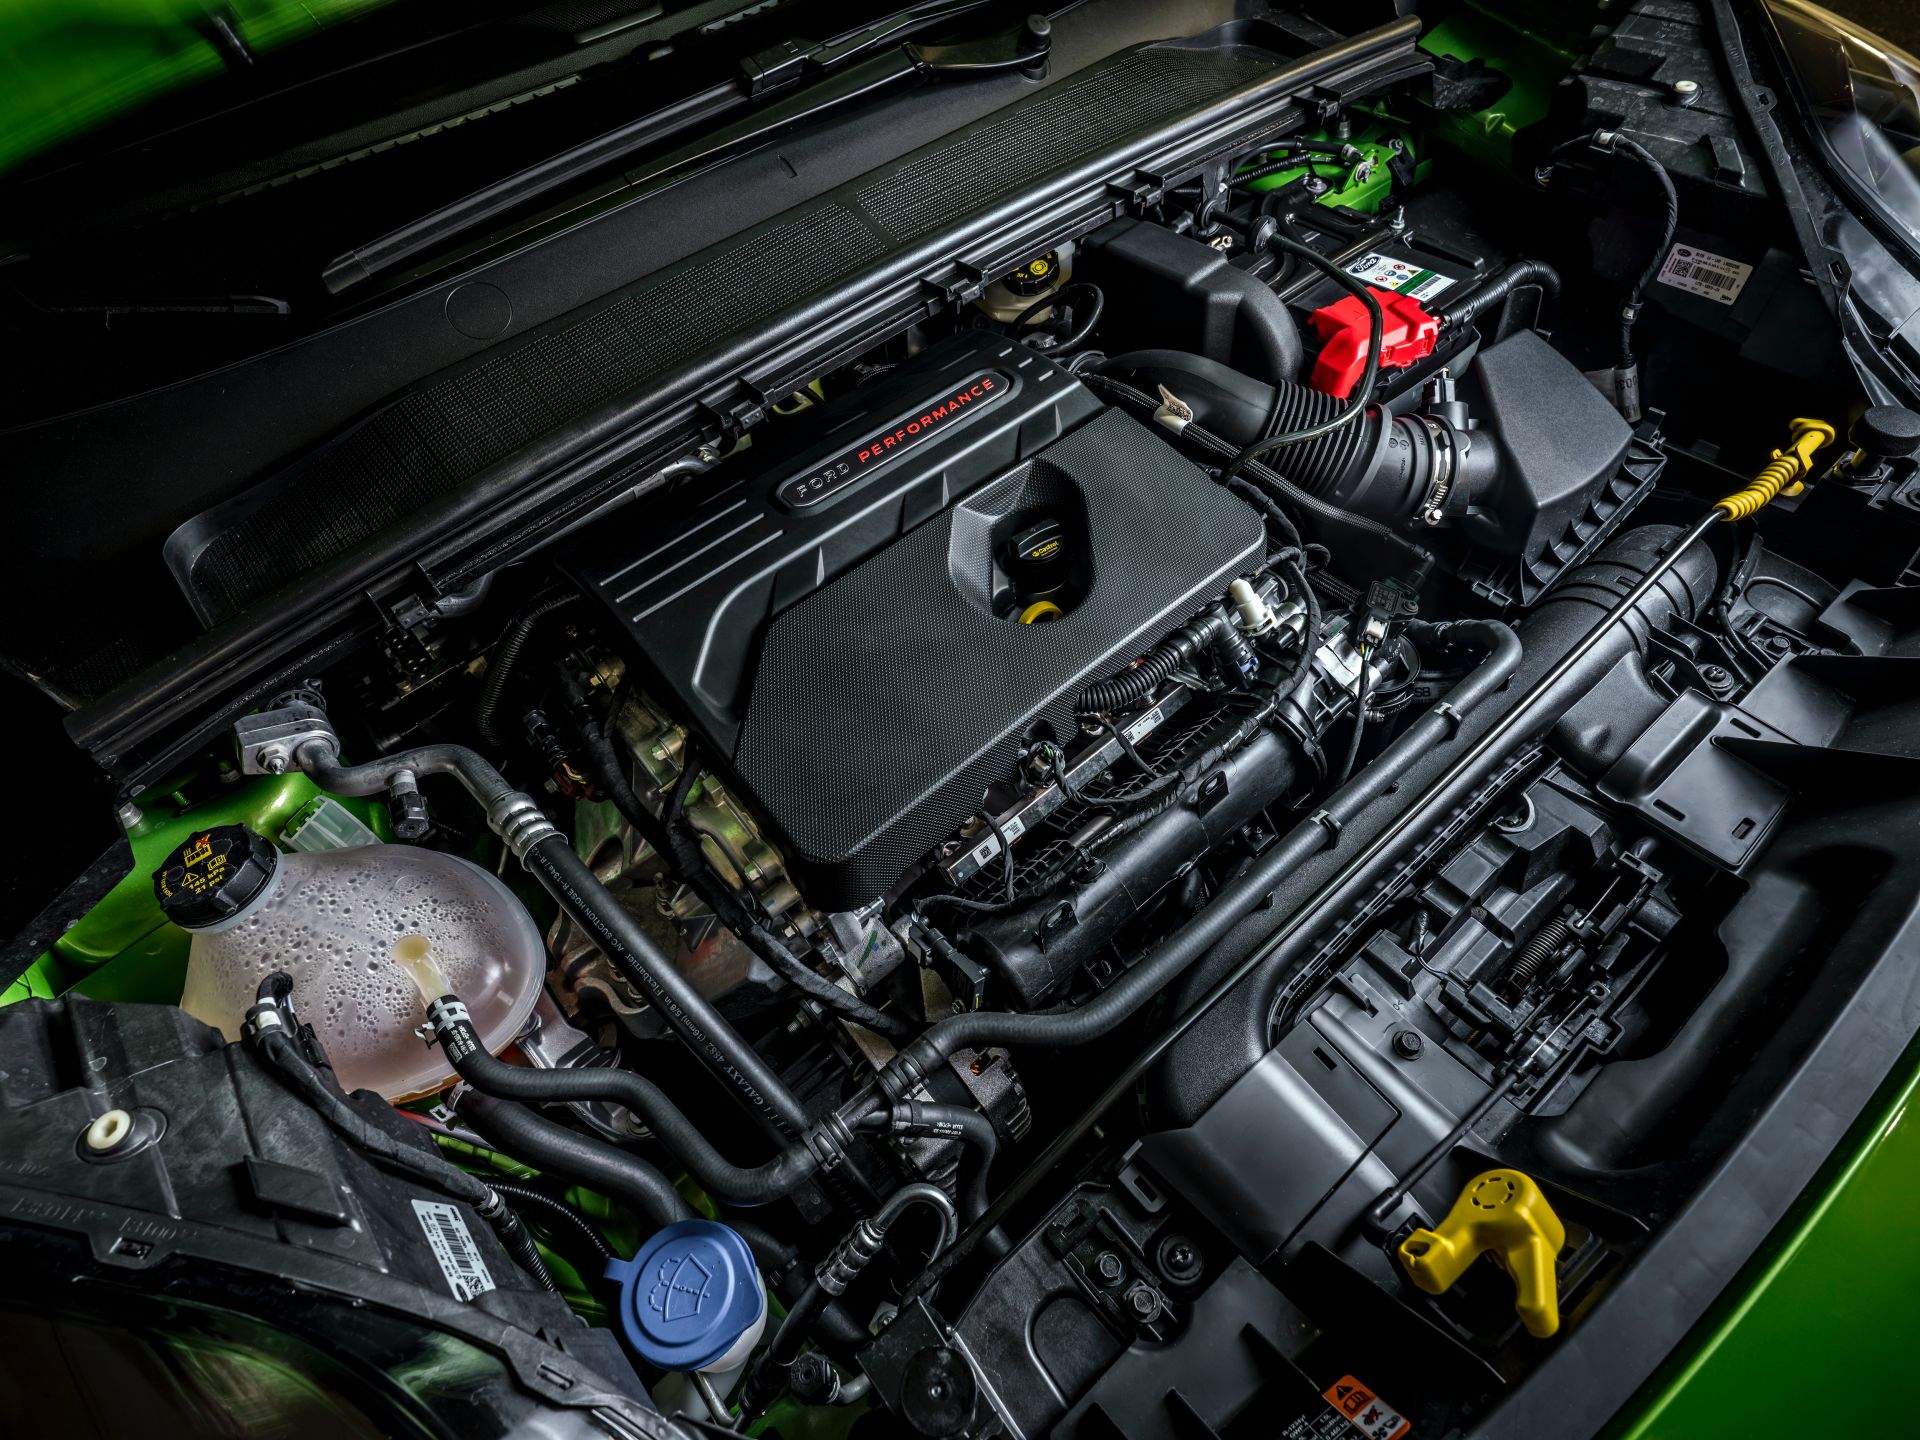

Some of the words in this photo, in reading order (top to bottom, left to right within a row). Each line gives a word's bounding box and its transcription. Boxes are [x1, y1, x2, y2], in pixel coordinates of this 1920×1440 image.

[797, 462, 850, 498] FORD
[858, 378, 995, 463] PERFORMANCE
[1038, 540, 1059, 554] Castrol
[189, 877, 206, 890] 145
[207, 866, 225, 879] kPa
[195, 884, 206, 894] 21
[209, 874, 223, 887] psi
[567, 889, 585, 908] HOSE
[584, 908, 612, 938] SUCTION
[609, 936, 624, 952] A/C
[624, 953, 663, 996] Flexbarrier
[662, 995, 672, 1005] in
[669, 1002, 683, 1016] 5/8
[680, 1014, 706, 1041] (16mm)
[705, 1042, 725, 1063] 4882
[724, 1064, 764, 1105] GALAXY
